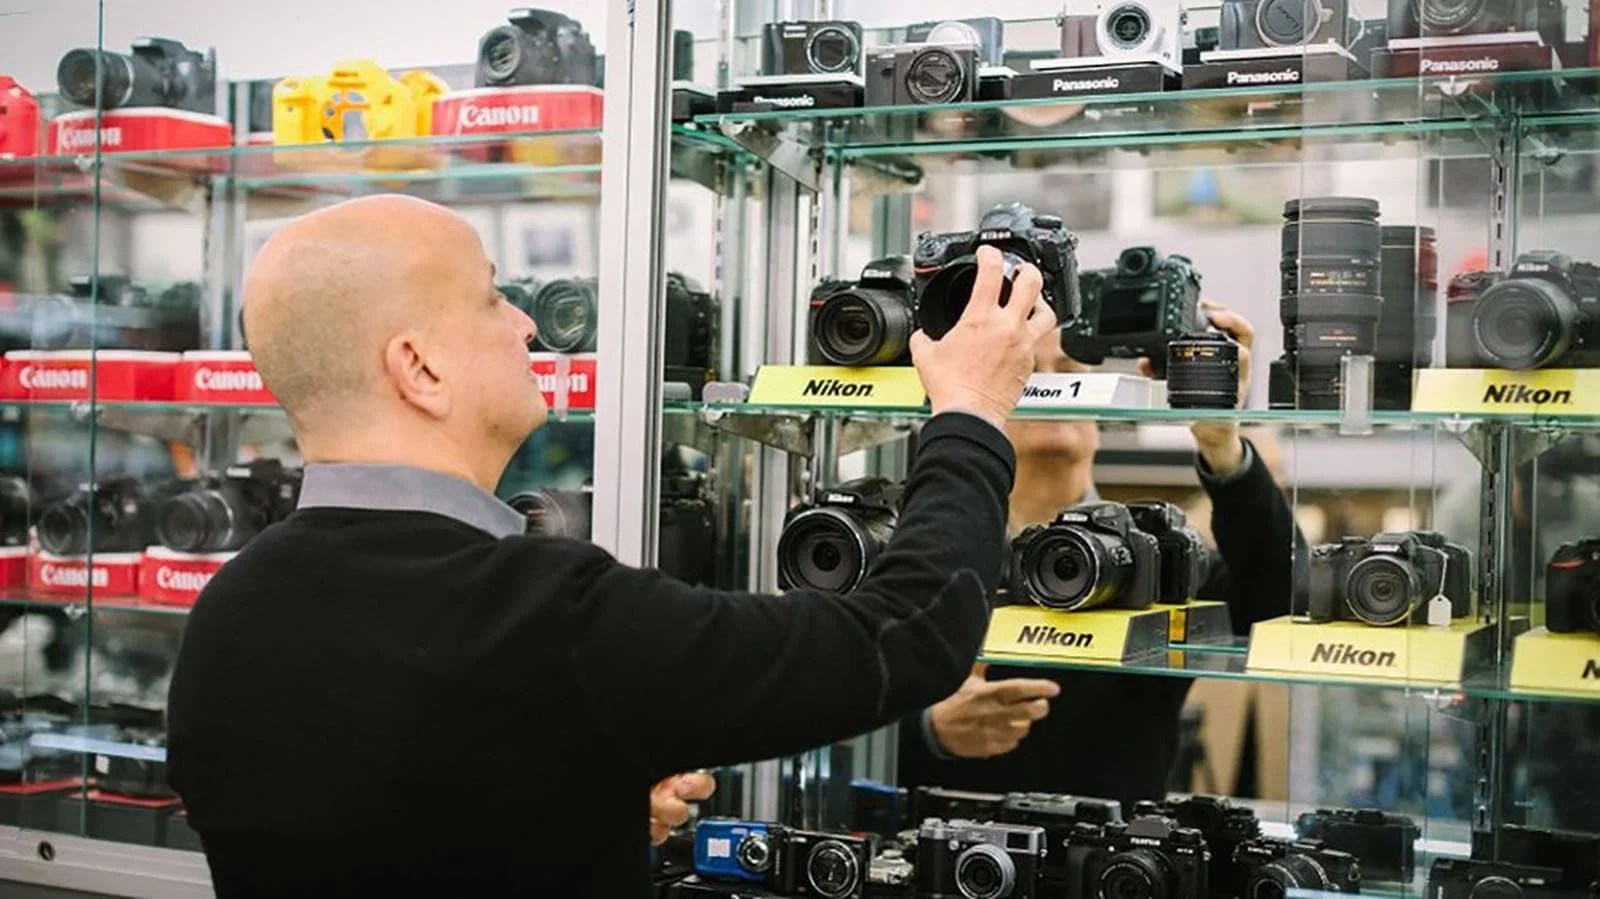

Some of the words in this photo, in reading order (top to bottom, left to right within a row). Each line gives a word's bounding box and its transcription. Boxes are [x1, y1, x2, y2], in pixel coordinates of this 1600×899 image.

[1421, 57, 1499, 74] Panasonic
[1053, 77, 1119, 92] Panasonic
[1227, 70, 1299, 85] Panasonic
[459, 103, 540, 128] Canon
[60, 125, 122, 149] Canon
[981, 230, 1010, 240] Nikon
[1517, 263, 1549, 272] Nikon
[19, 366, 87, 388] Canon
[194, 367, 263, 390] Canon
[803, 379, 874, 397] Nikon
[1022, 386, 1062, 398] ikon
[1069, 380, 1082, 398] 1
[1482, 384, 1571, 405] Nikon
[41, 566, 108, 587] Canon
[1017, 625, 1093, 648] Nikon
[1311, 643, 1397, 667] Nikon
